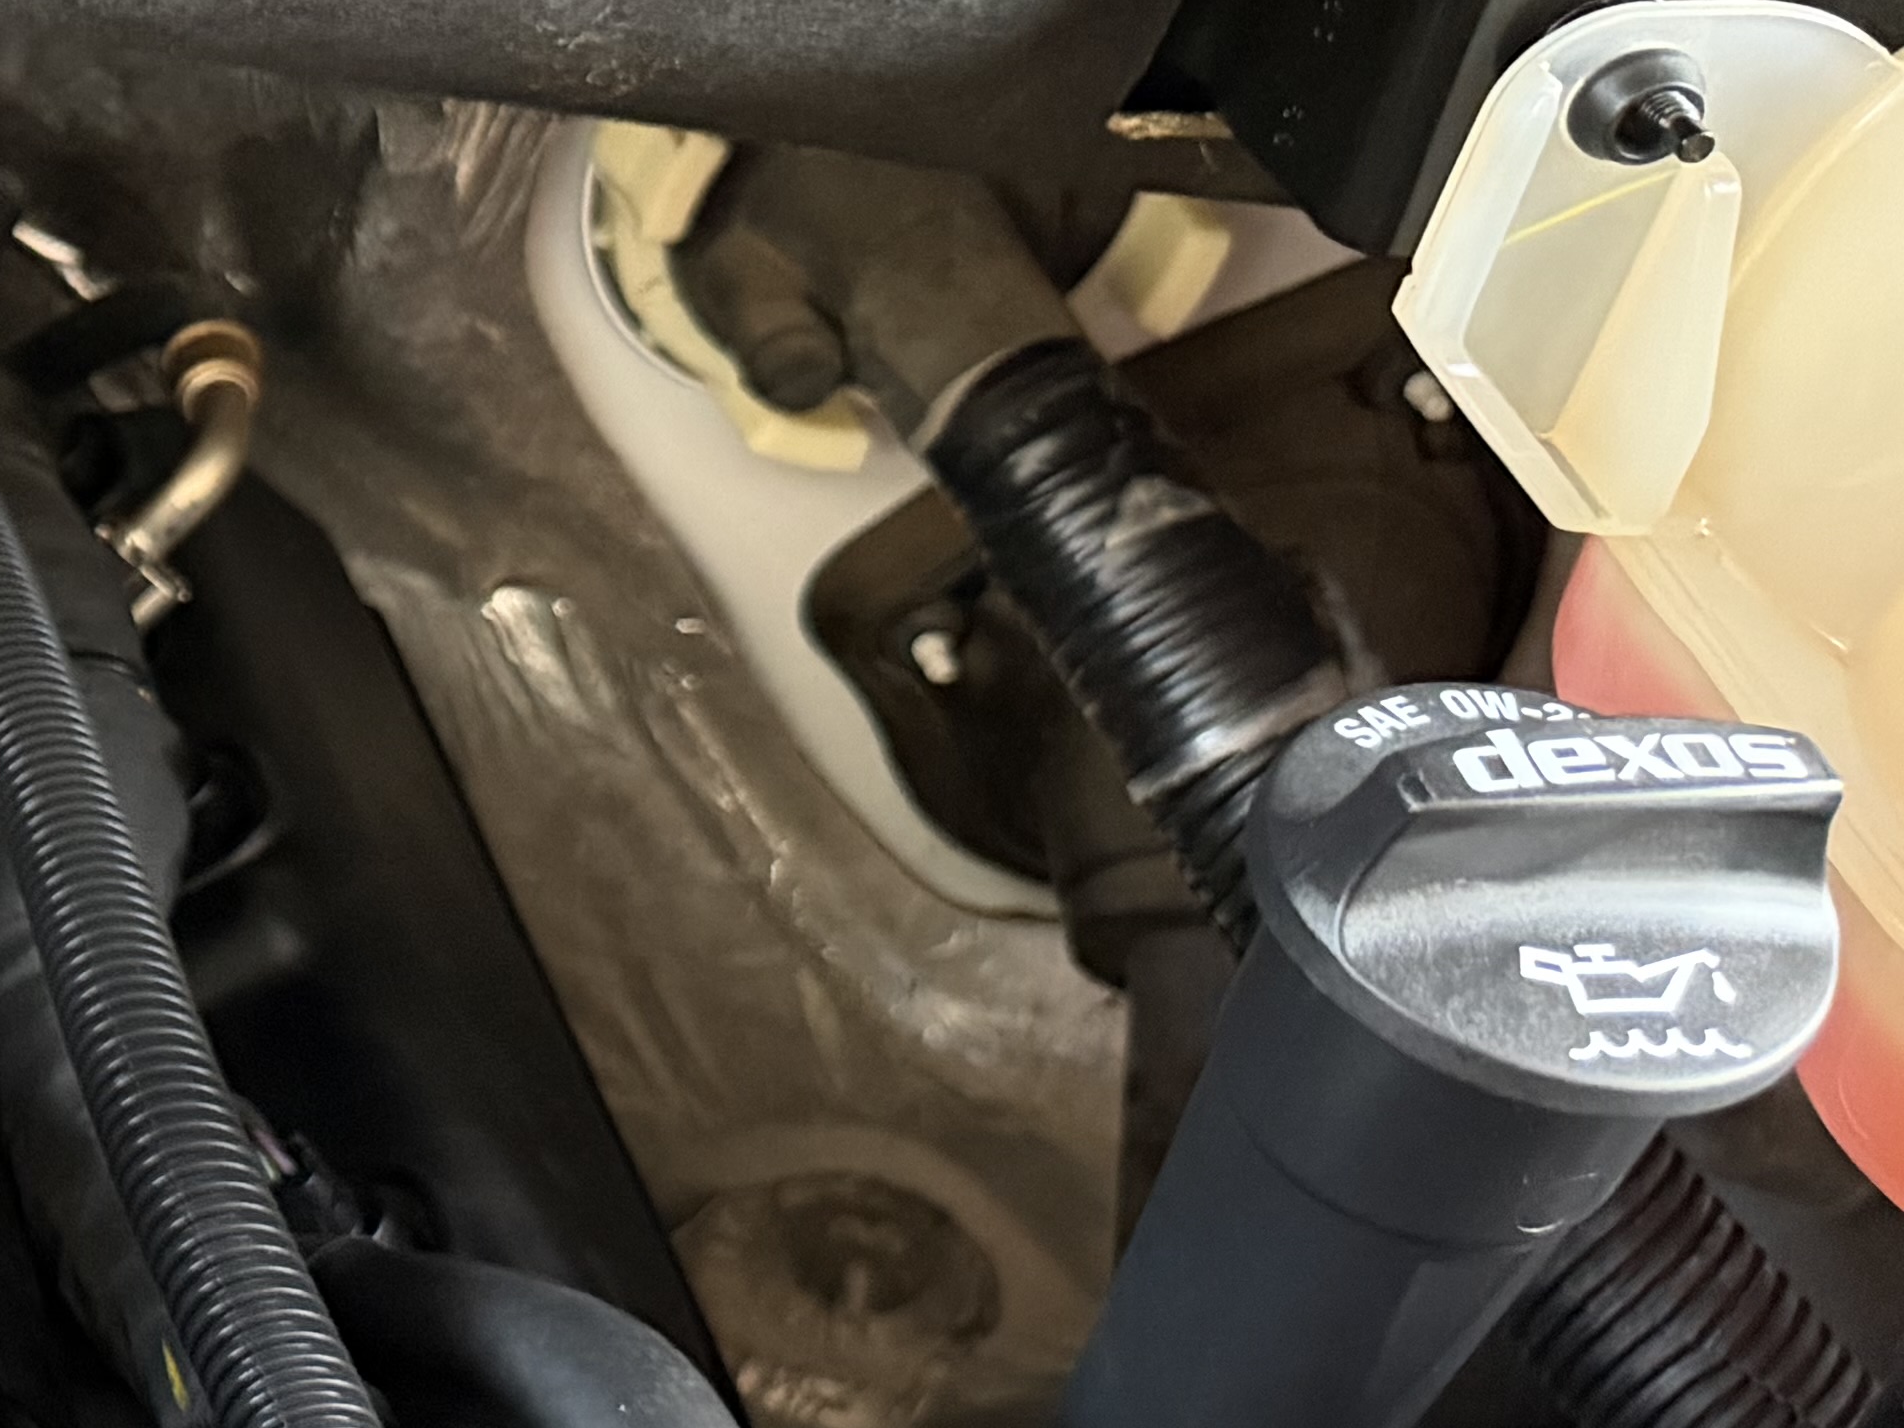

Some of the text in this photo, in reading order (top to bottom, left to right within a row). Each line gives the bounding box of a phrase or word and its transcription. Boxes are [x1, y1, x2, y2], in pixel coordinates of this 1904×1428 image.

[1333, 688, 1591, 749] SAE 0W-2
[1452, 727, 1809, 793] dexos
